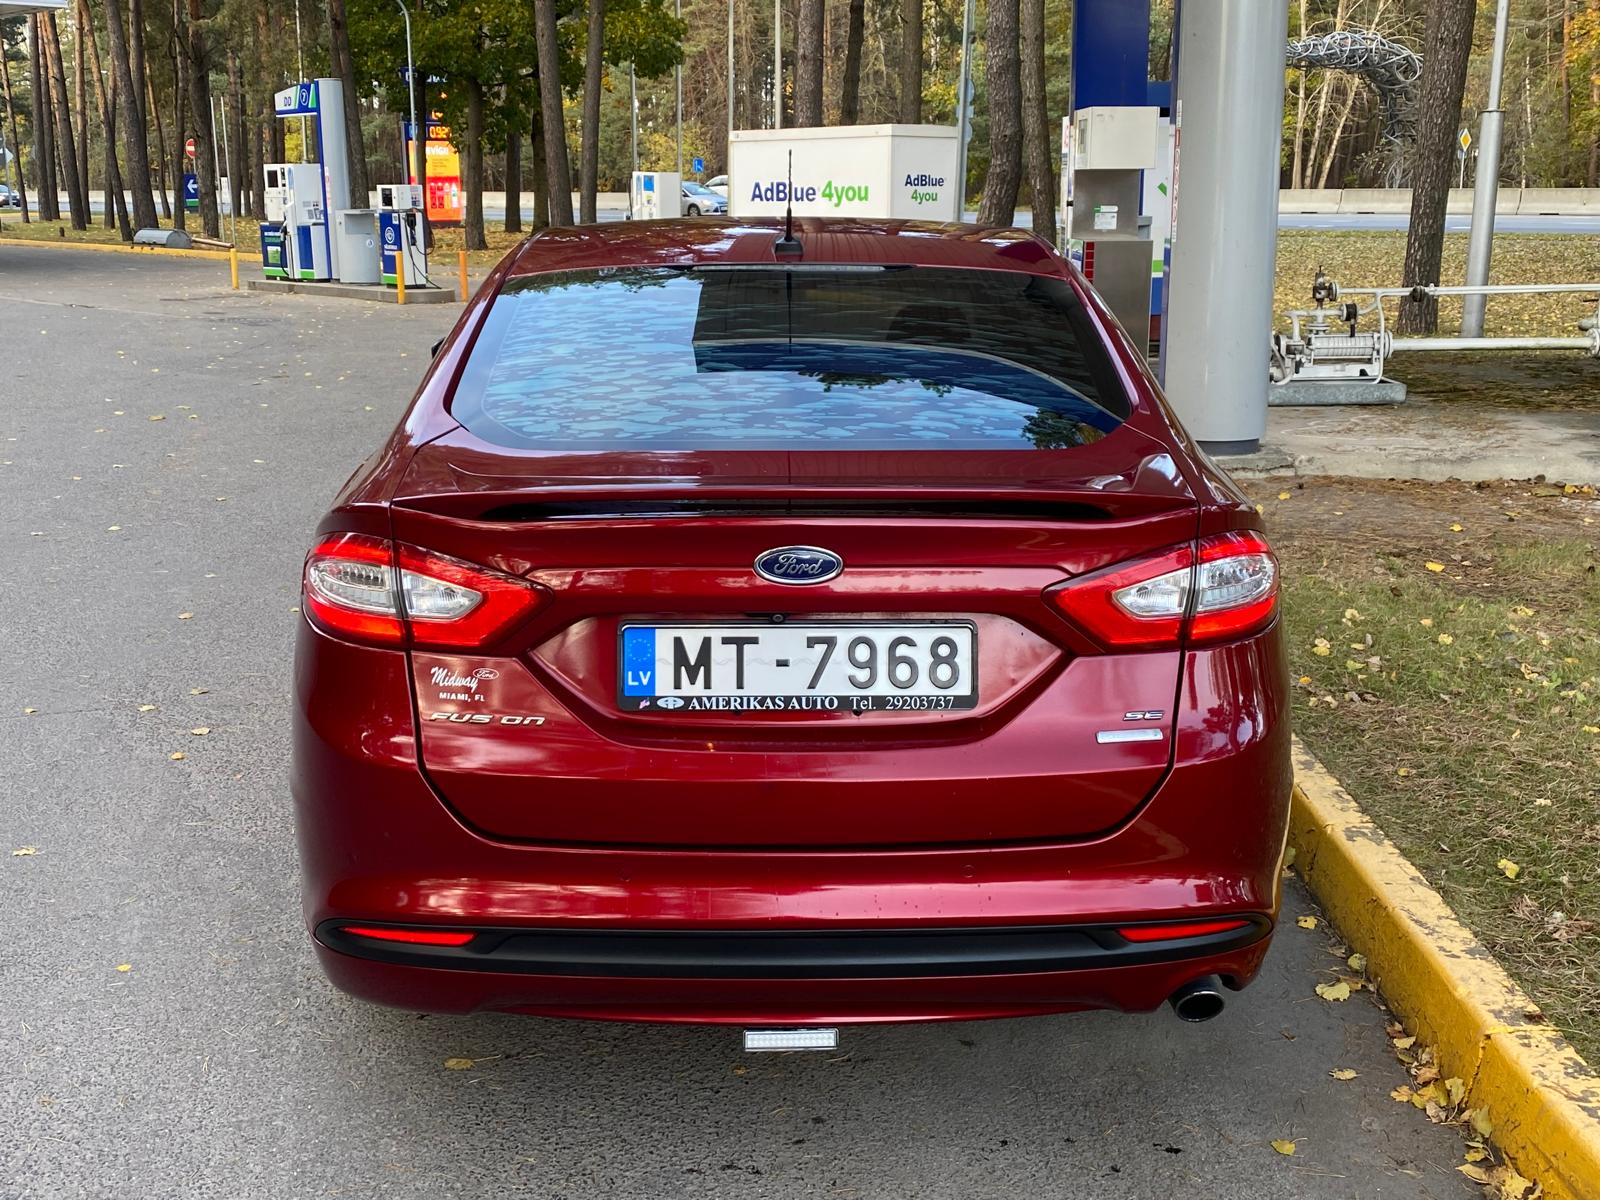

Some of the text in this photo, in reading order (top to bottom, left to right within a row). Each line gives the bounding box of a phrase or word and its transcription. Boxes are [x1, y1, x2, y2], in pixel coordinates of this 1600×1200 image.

[904, 174, 945, 187] AdBlue
[751, 180, 869, 208] AdBlue 4you
[911, 189, 938, 205] 4you
[774, 553, 823, 574] Ford
[430, 666, 495, 693] Midway Ford
[628, 671, 651, 686] LV
[439, 692, 486, 702] MIAMI, FL
[688, 697, 955, 710] AMERIKAS AUTO Tel. 29203737
[1122, 711, 1165, 721] SE
